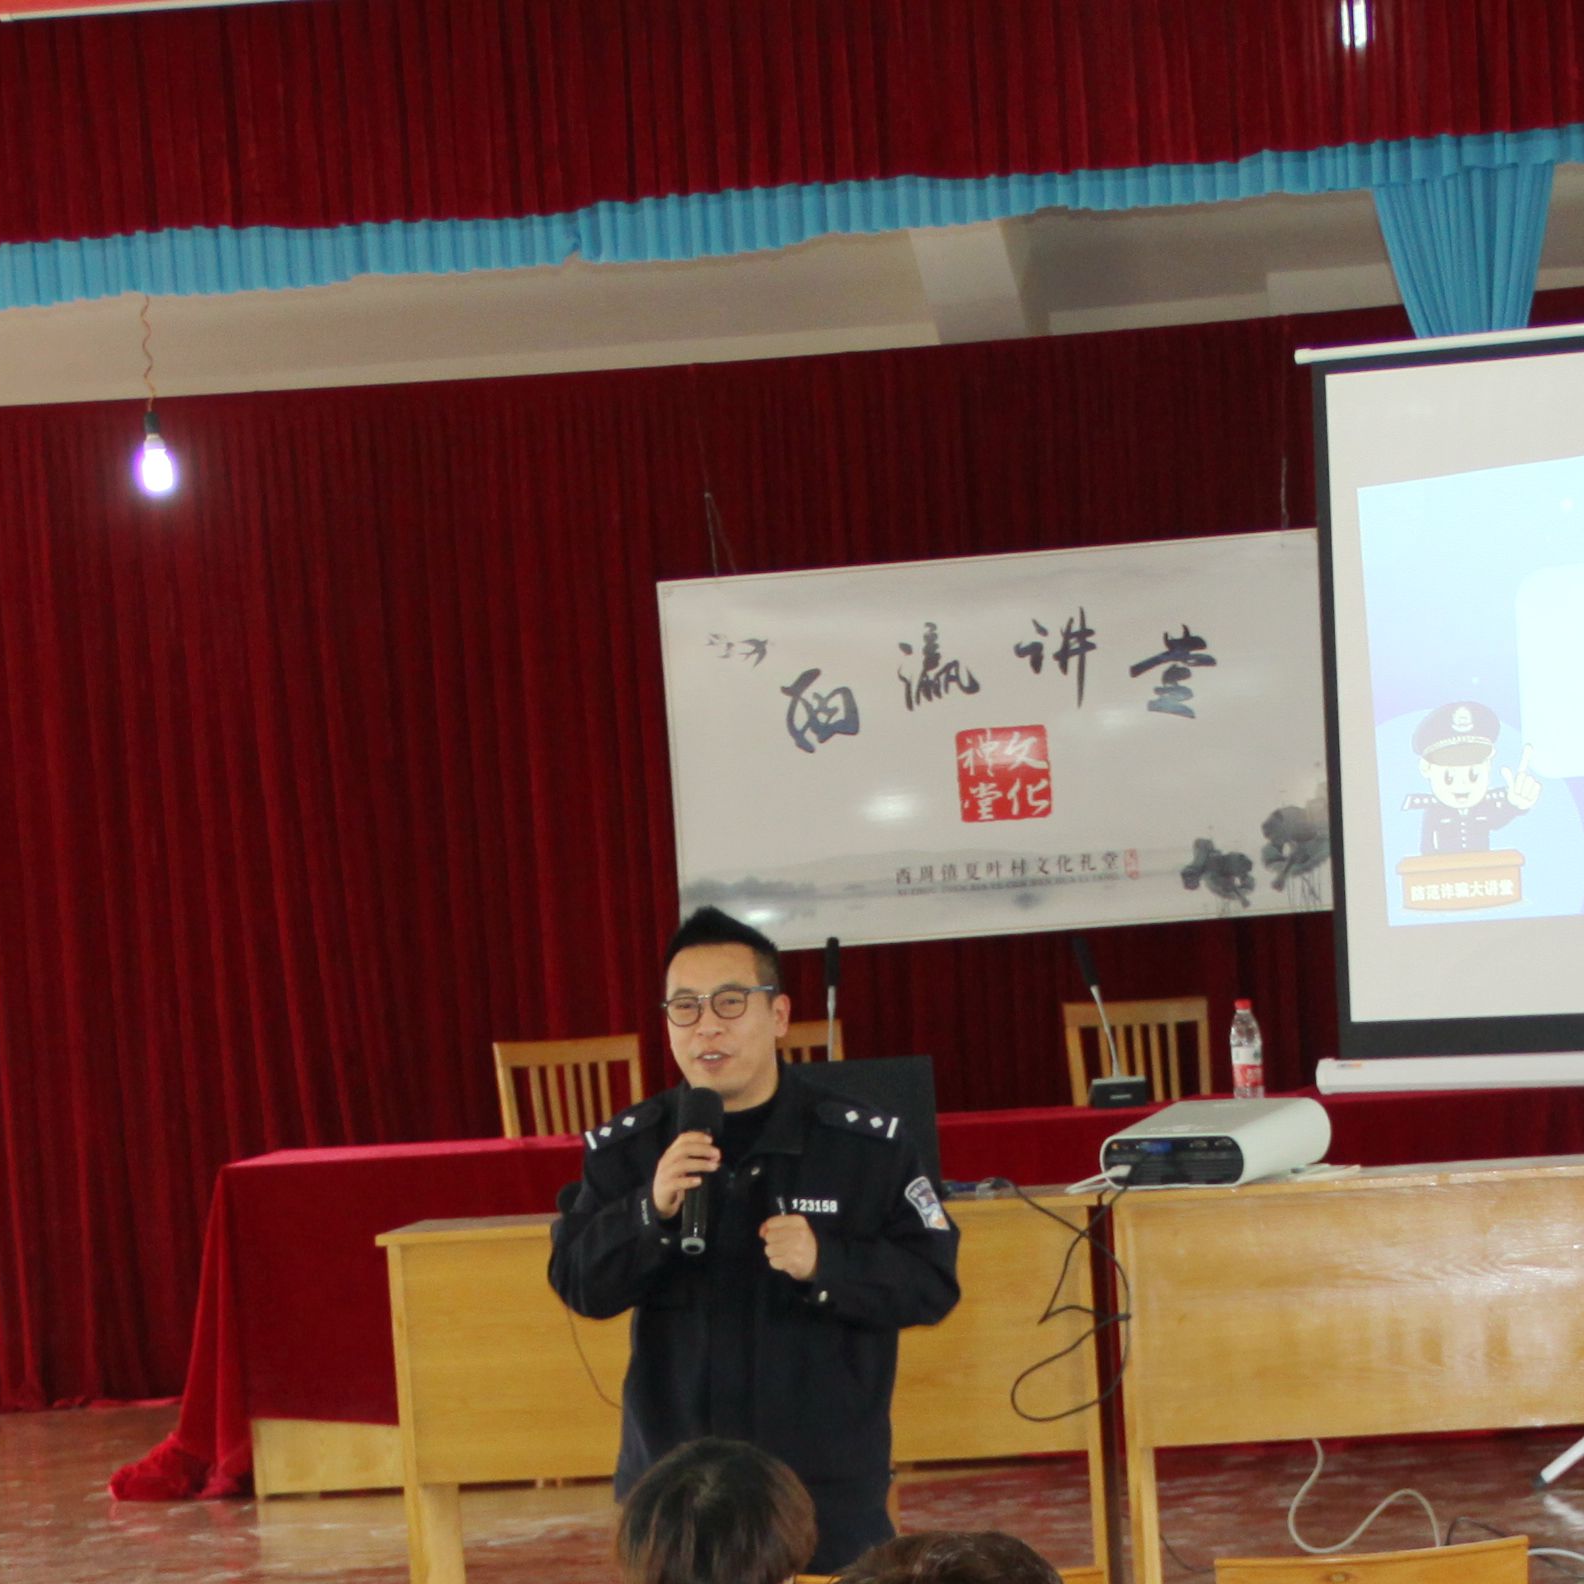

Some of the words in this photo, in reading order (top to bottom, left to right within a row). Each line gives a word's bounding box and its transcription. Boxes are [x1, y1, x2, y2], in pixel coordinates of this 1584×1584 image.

[1410, 879, 1514, 902] 防范诈骗大讲堂
